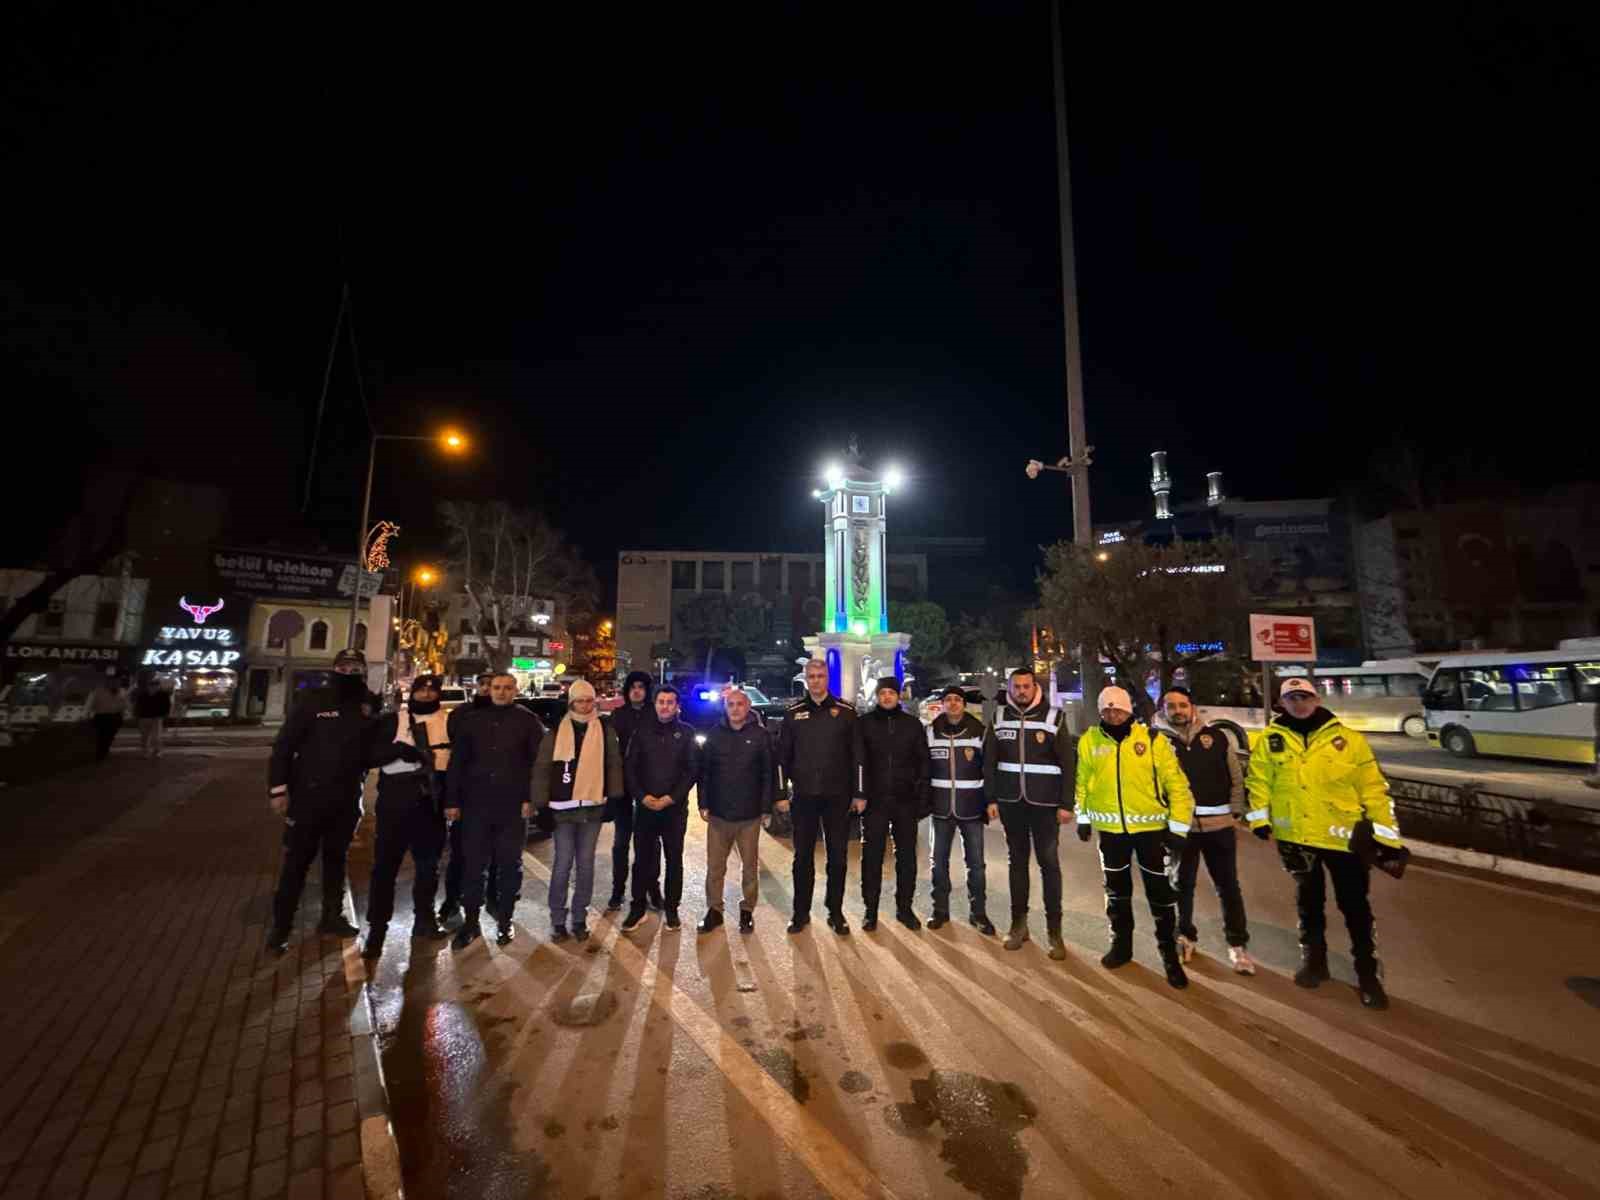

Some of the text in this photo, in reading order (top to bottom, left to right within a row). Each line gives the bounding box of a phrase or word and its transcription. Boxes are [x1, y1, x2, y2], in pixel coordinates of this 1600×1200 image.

[160, 626, 233, 641] YAVUZ
[6, 646, 119, 660] LOKANTASI
[141, 648, 241, 667] KASAP
